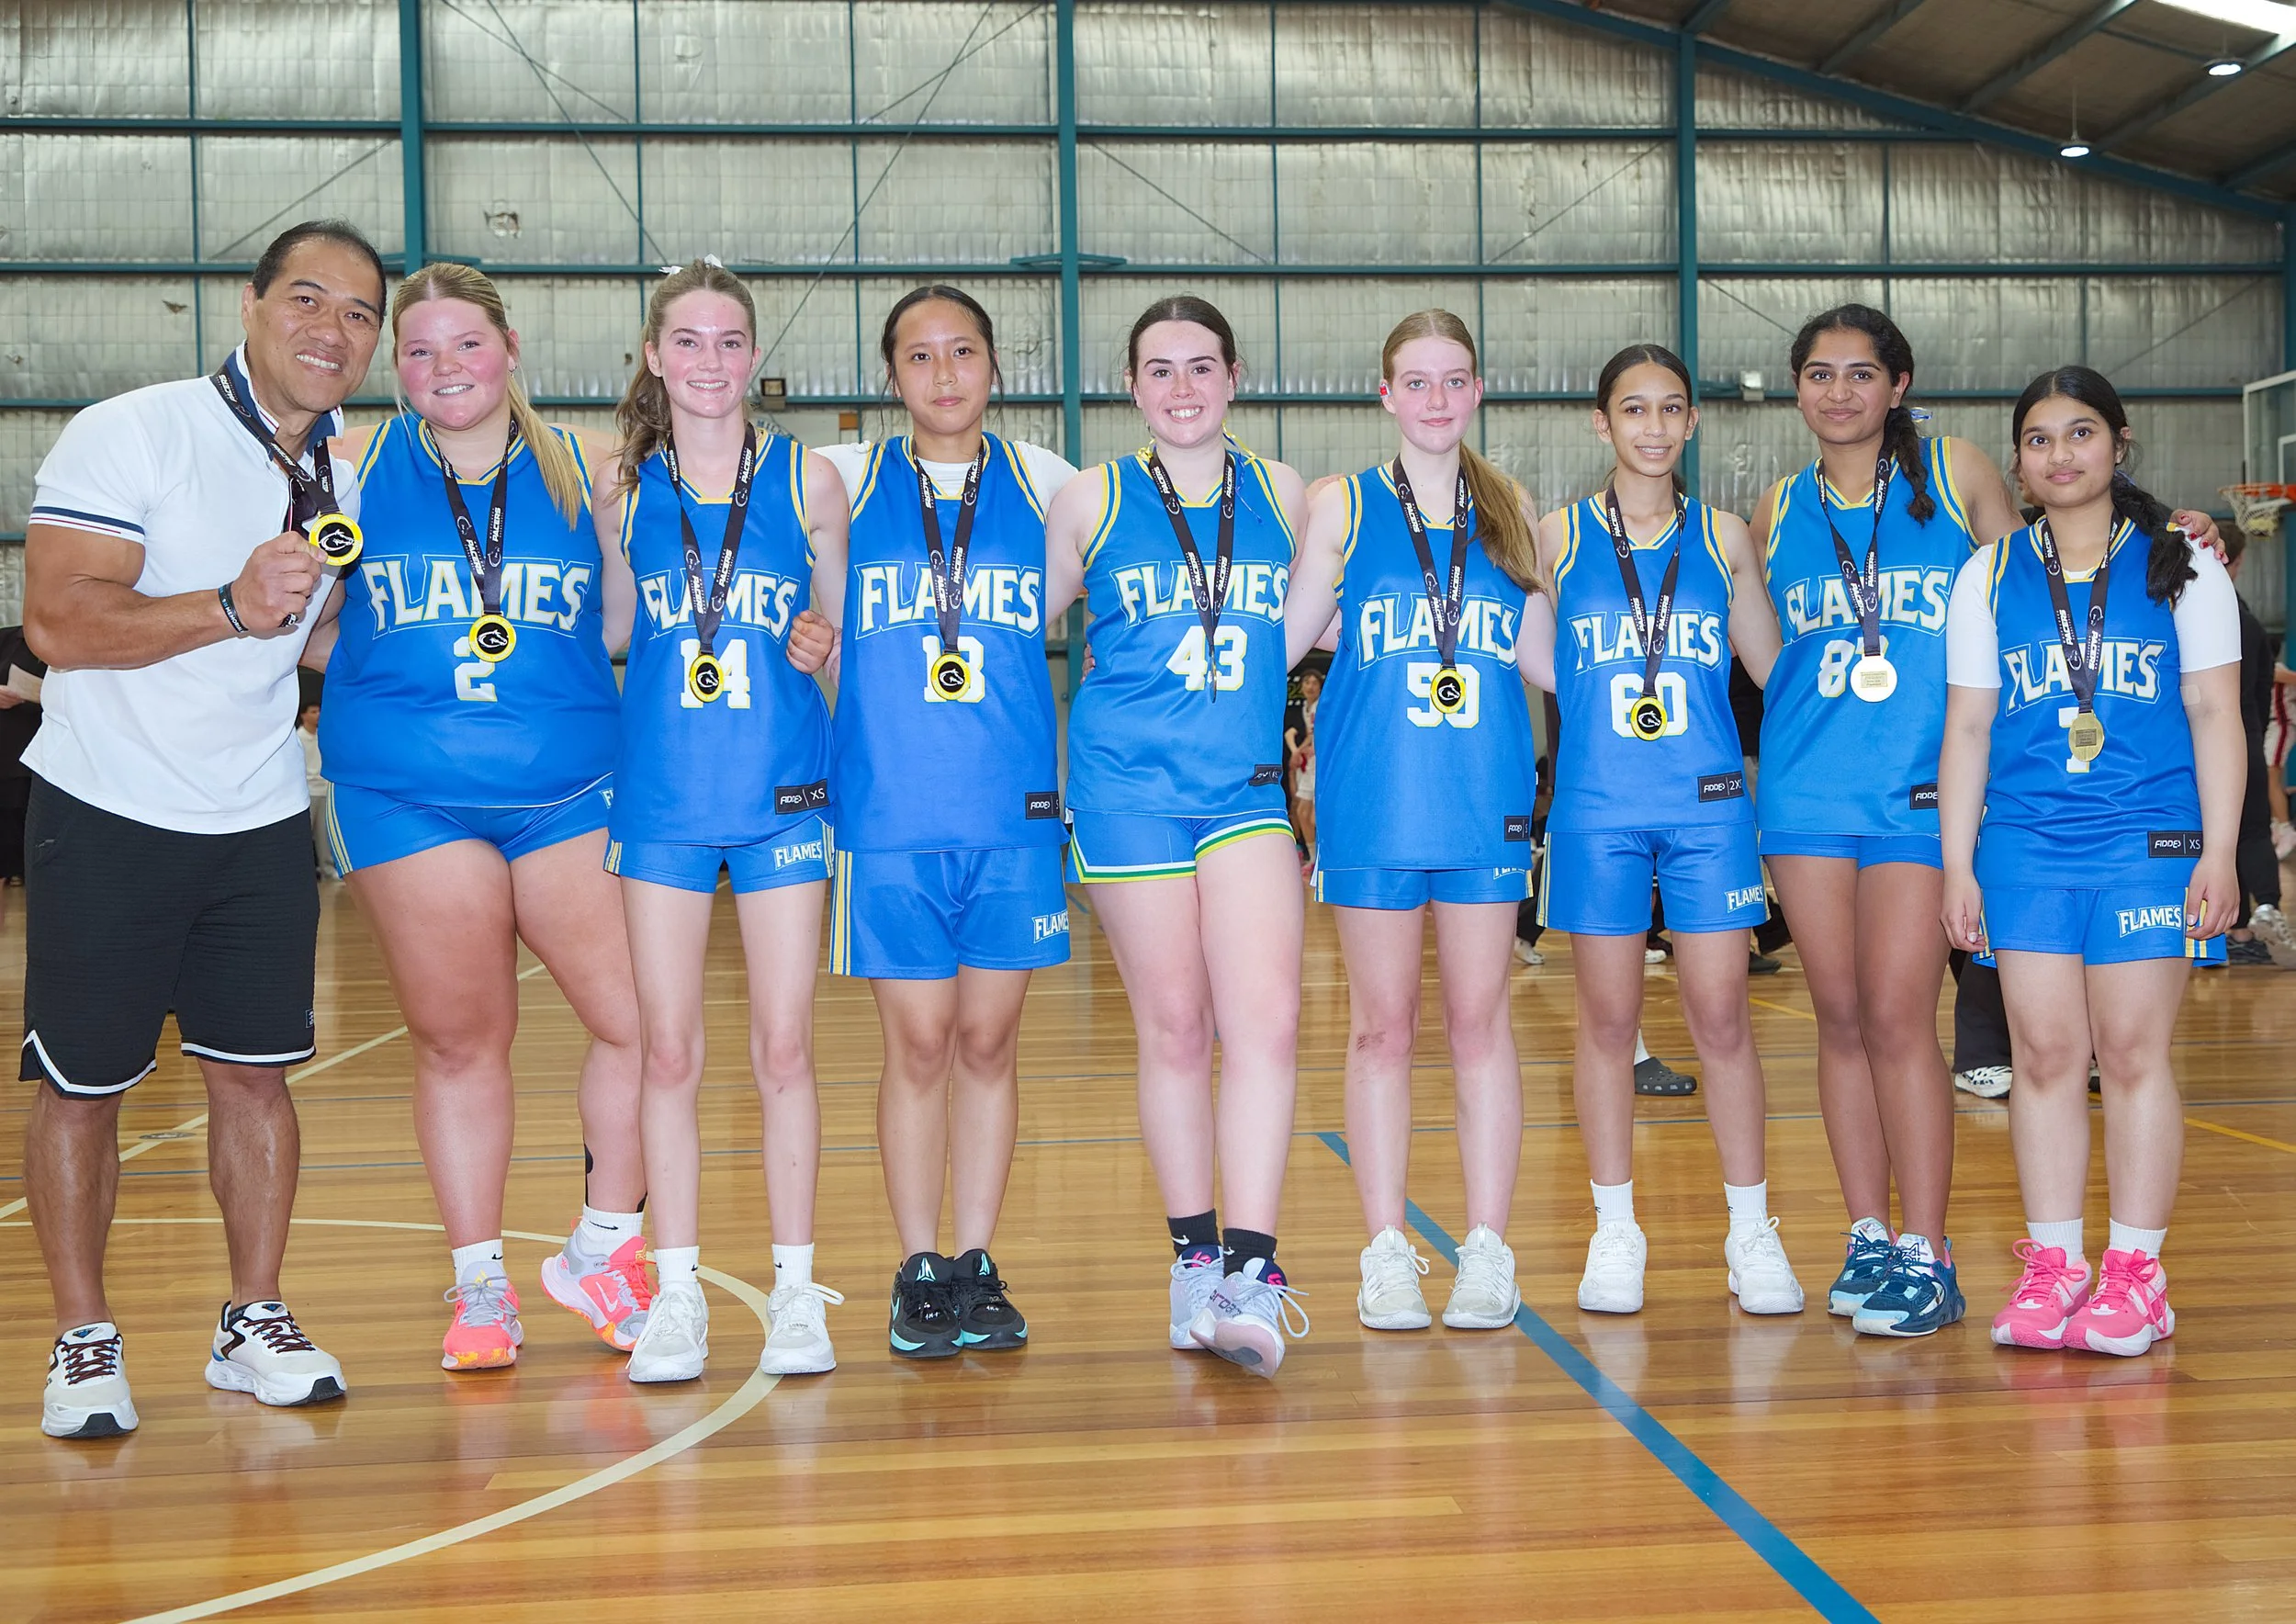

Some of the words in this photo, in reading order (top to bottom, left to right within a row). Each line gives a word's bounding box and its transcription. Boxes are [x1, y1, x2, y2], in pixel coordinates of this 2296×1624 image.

[741, 447, 752, 484] PACERS
[970, 452, 980, 484] PACER
[1154, 466, 1170, 494] PACERS
[1225, 465, 1233, 499] PACERS
[921, 473, 932, 509] PACERS
[491, 506, 502, 543] PACERS
[1404, 502, 1421, 534] PACERS
[1609, 507, 1622, 537] PACERS
[466, 538, 485, 576] PACERS
[718, 548, 733, 588] PACERS
[953, 546, 963, 584] PACERS
[1187, 551, 1203, 587] PACERS
[1218, 556, 1228, 593] PACERS
[361, 560, 591, 632] FLAMES
[692, 575, 704, 615] PACERS
[860, 566, 1041, 633] FLAMES
[936, 574, 948, 613] PACERS
[1114, 564, 1289, 626] FLAMES
[1451, 565, 1461, 603] PACERS
[1359, 597, 1516, 665] FLAMES
[1432, 596, 1445, 633] PACERS
[1633, 597, 1646, 632] PACERS
[1658, 595, 1670, 631] PACERS
[2059, 609, 2074, 646] PACERS
[1165, 625, 1248, 692] 43
[2088, 630, 2099, 671] PACERS
[453, 636, 498, 703] 2
[681, 638, 751, 709] 14
[1610, 671, 1689, 739] 60
[809, 787, 826, 801] XS
[773, 840, 823, 868] FLAMES
[2189, 839, 2201, 850] XS
[1727, 885, 1763, 910] FLAMES
[1034, 911, 1070, 942] FLAME
[2118, 907, 2182, 935] FLAMES
